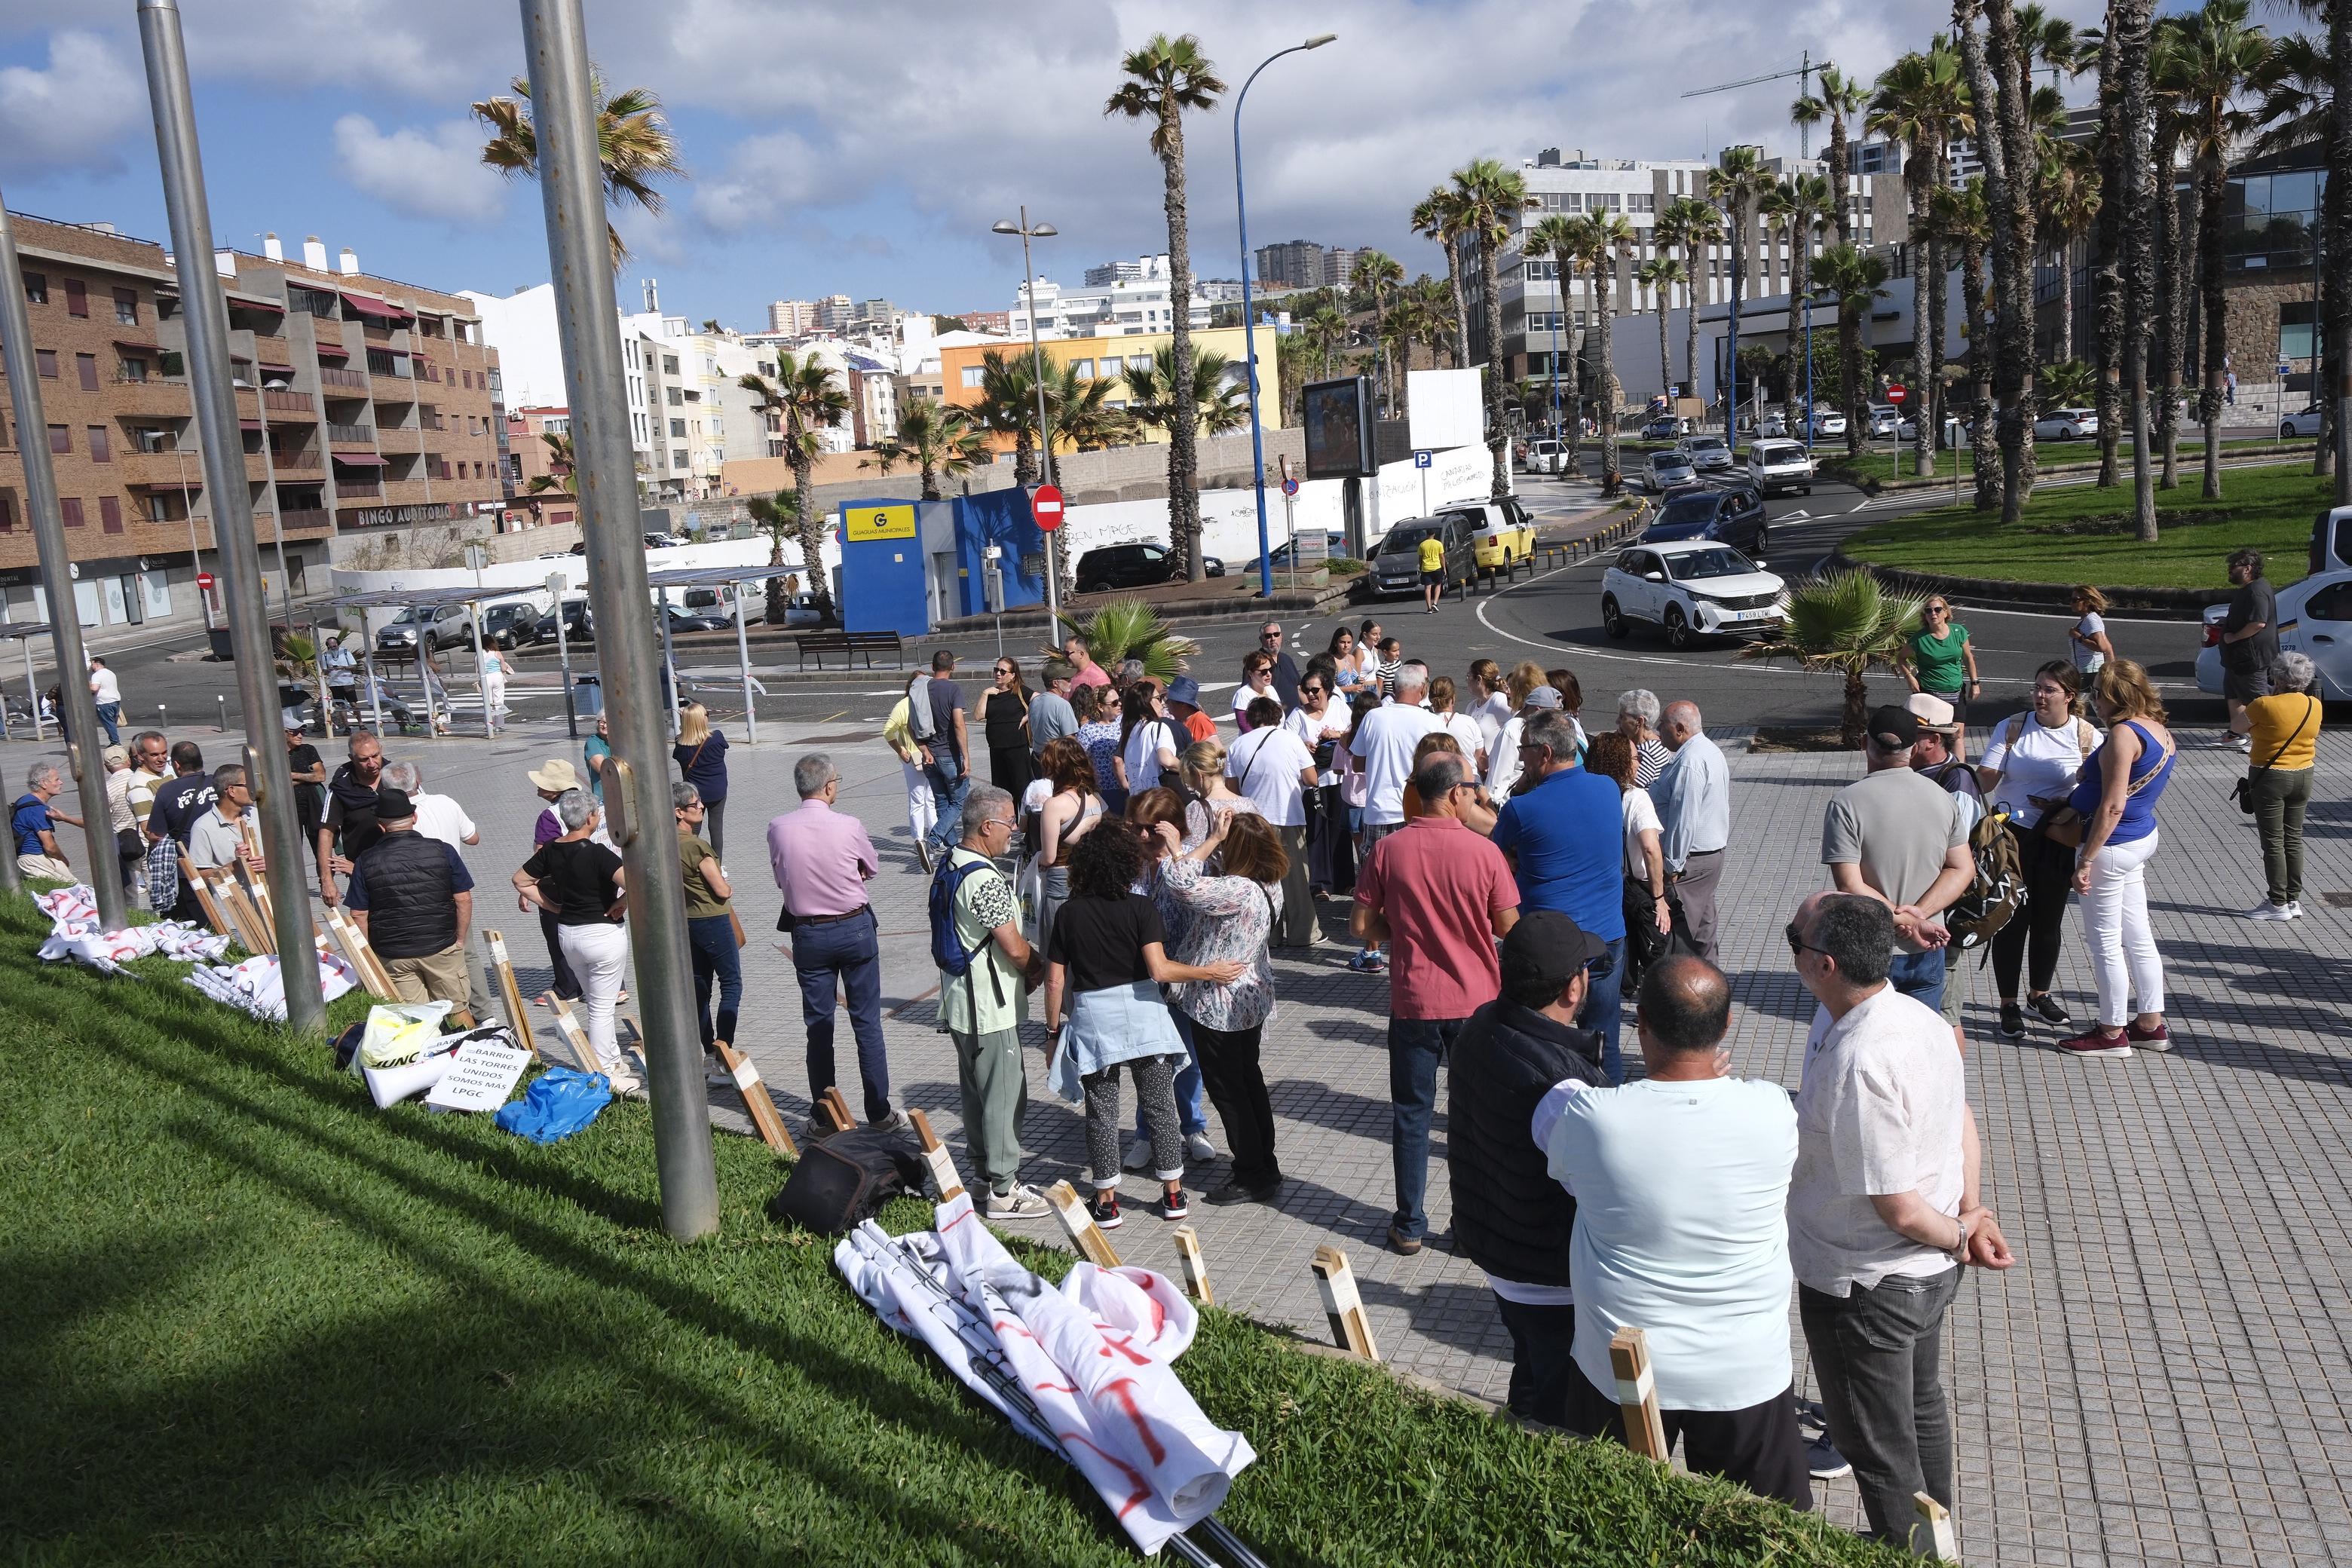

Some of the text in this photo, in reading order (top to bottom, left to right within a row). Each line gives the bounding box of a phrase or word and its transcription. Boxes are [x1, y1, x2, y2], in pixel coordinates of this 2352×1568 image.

[1418, 453, 1428, 467] P
[357, 505, 451, 525] BINGO AUDITORIO
[475, 1049, 514, 1060] BARRIO
[459, 1056, 519, 1071] LAS TORRES
[463, 1067, 504, 1080] UNIDOS
[447, 1075, 483, 1086] SOMOS
[452, 1086, 485, 1098] LPGC
